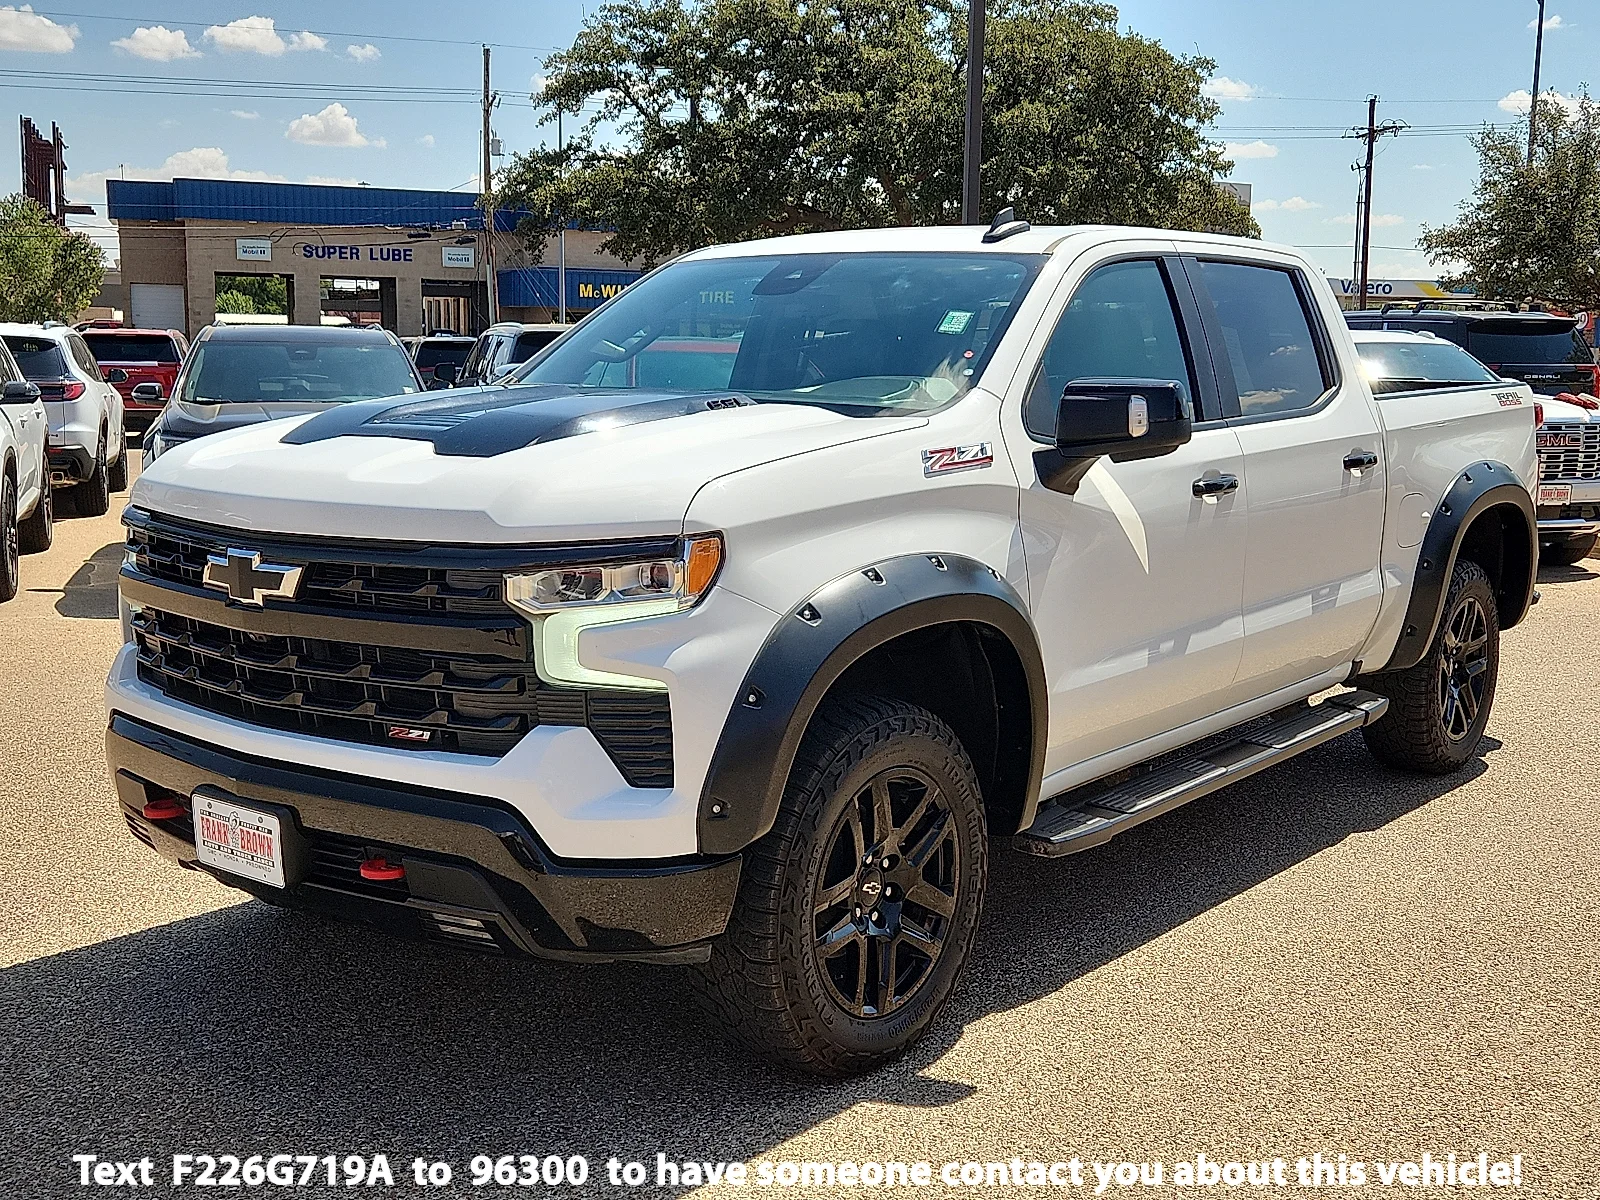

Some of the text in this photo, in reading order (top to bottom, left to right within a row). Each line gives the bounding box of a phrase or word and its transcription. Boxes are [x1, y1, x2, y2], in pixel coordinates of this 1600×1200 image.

[302, 244, 413, 262] SUPER LUBE
[699, 291, 735, 304] TIRE
[1491, 391, 1524, 401] TRAIL
[1499, 399, 1523, 407] BOSS
[1535, 433, 1582, 446] GMC
[921, 442, 994, 478] Z71
[389, 727, 431, 742] Z71
[943, 756, 971, 809] TRAIL
[200, 816, 231, 847] FRANK
[240, 828, 274, 860] BROWN
